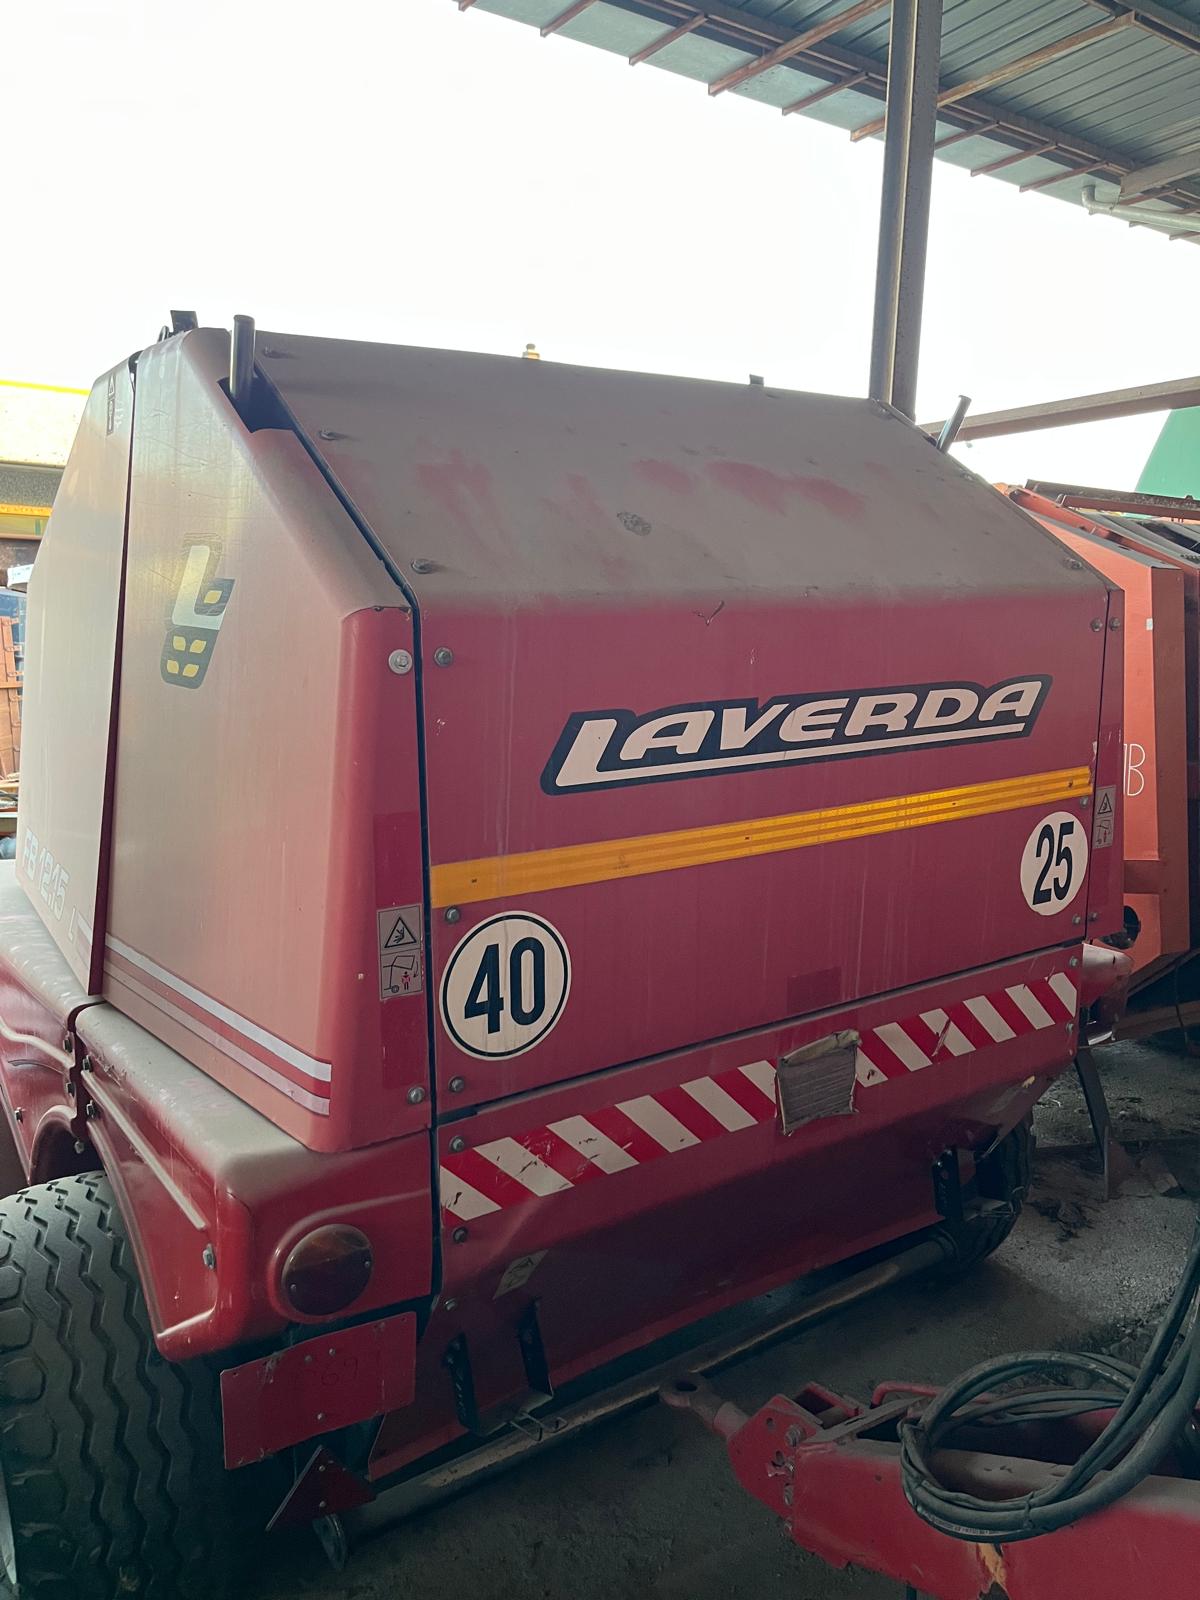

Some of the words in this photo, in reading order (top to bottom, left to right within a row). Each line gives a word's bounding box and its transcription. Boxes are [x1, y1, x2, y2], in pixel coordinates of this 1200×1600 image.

[555, 680, 1043, 788] LAVERDA
[23, 826, 39, 881] FB
[1032, 821, 1075, 906] 25
[464, 937, 546, 1035] 40
